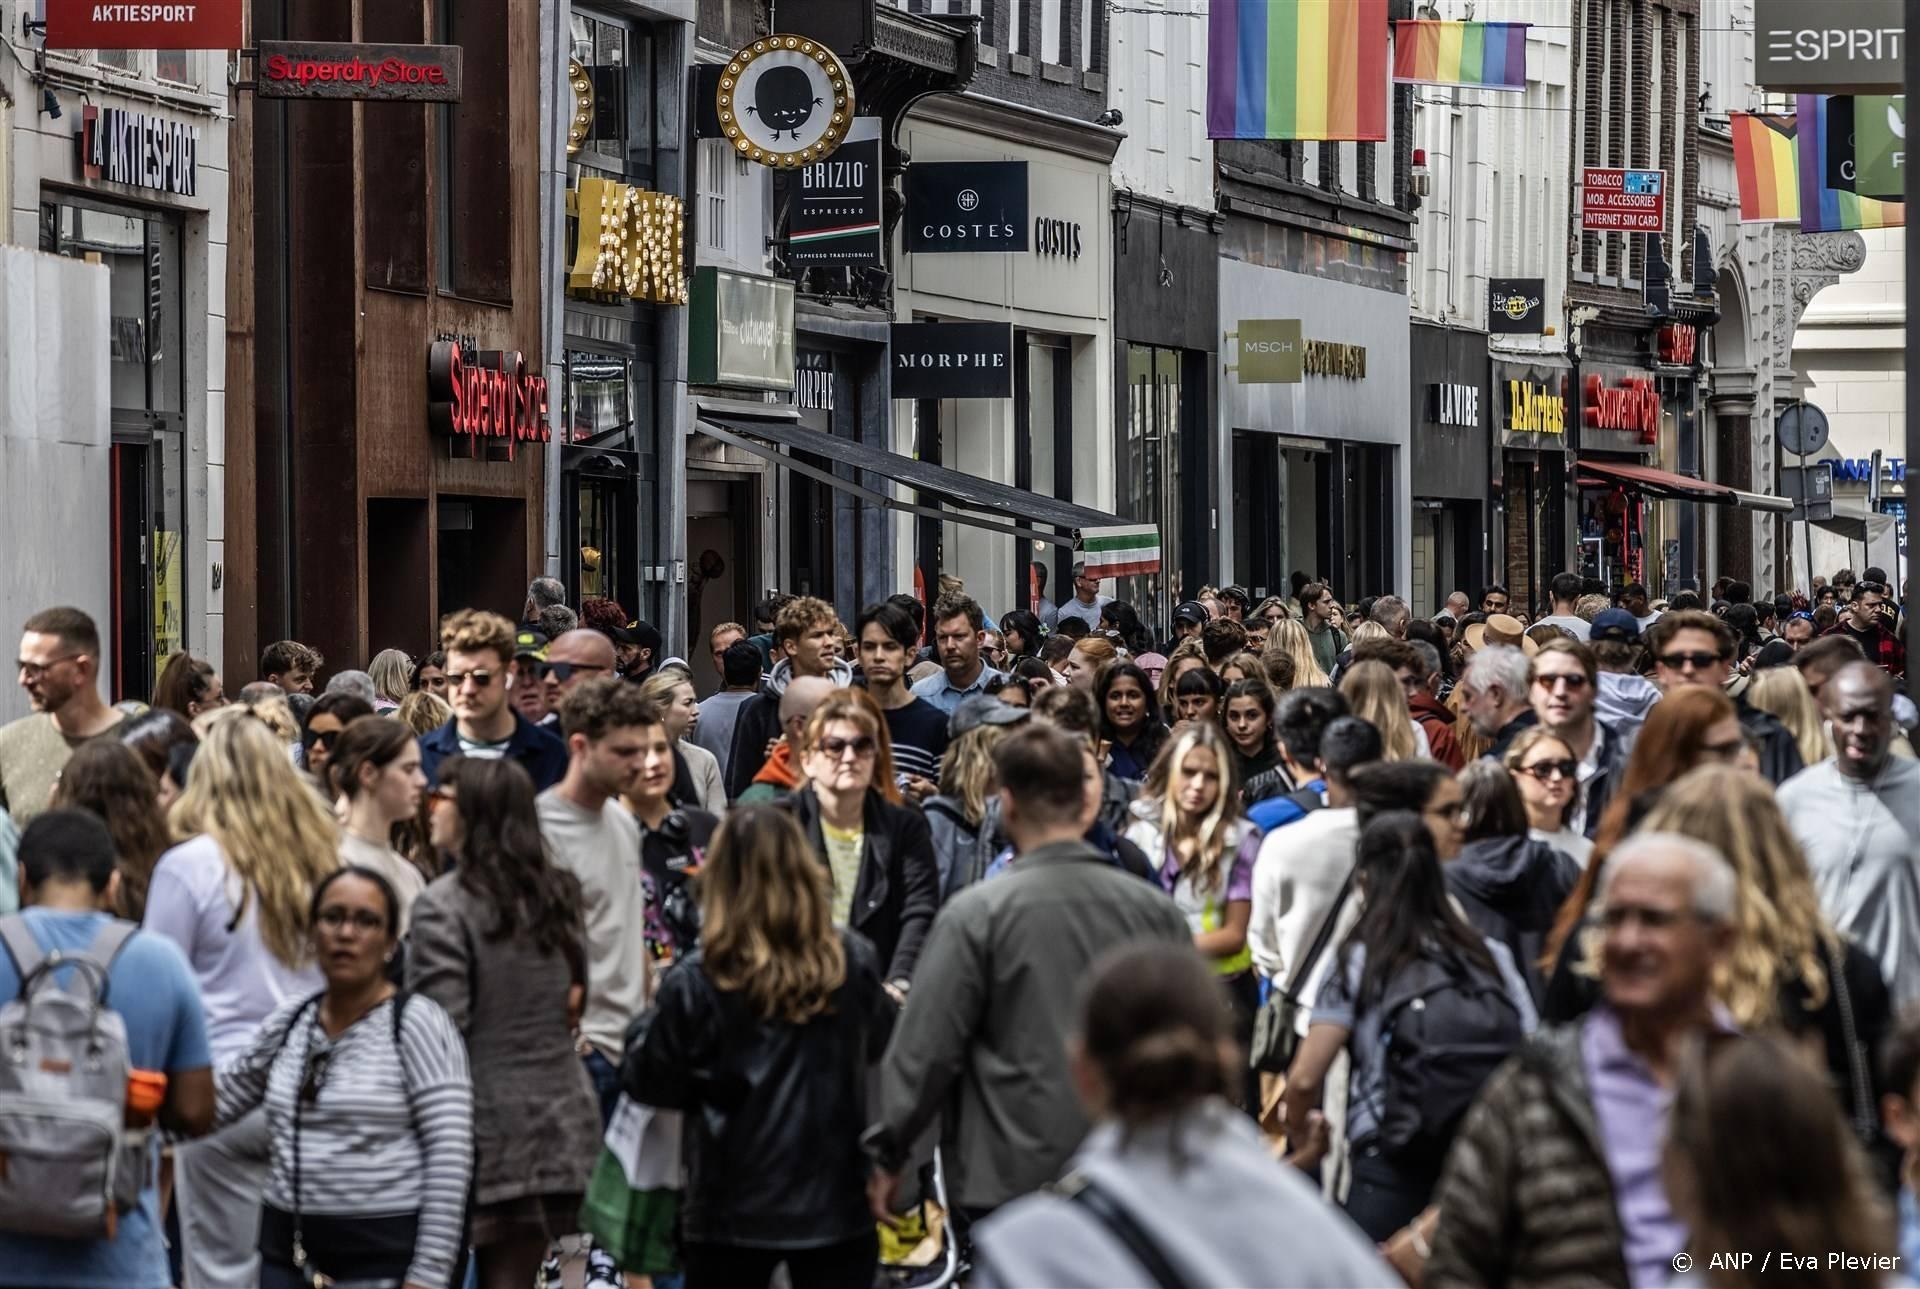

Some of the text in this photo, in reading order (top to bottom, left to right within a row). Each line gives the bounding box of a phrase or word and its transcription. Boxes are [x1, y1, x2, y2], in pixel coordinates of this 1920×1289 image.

[92, 5, 196, 22] AKTIESPORT
[1768, 28, 1905, 61] ESPRIT
[109, 109, 200, 197] AKTIESPORT
[803, 161, 863, 189] BRIZIO
[1587, 173, 1623, 187] TOBACCO
[1586, 192, 1656, 208] MOB. ACCESSORIES
[803, 208, 864, 216] ESPRESSO
[1585, 212, 1659, 227] INTERNET SIM CARD
[923, 224, 1014, 239] COSTES
[1245, 341, 1294, 353] MSCH
[898, 353, 1004, 368] MORPHE
